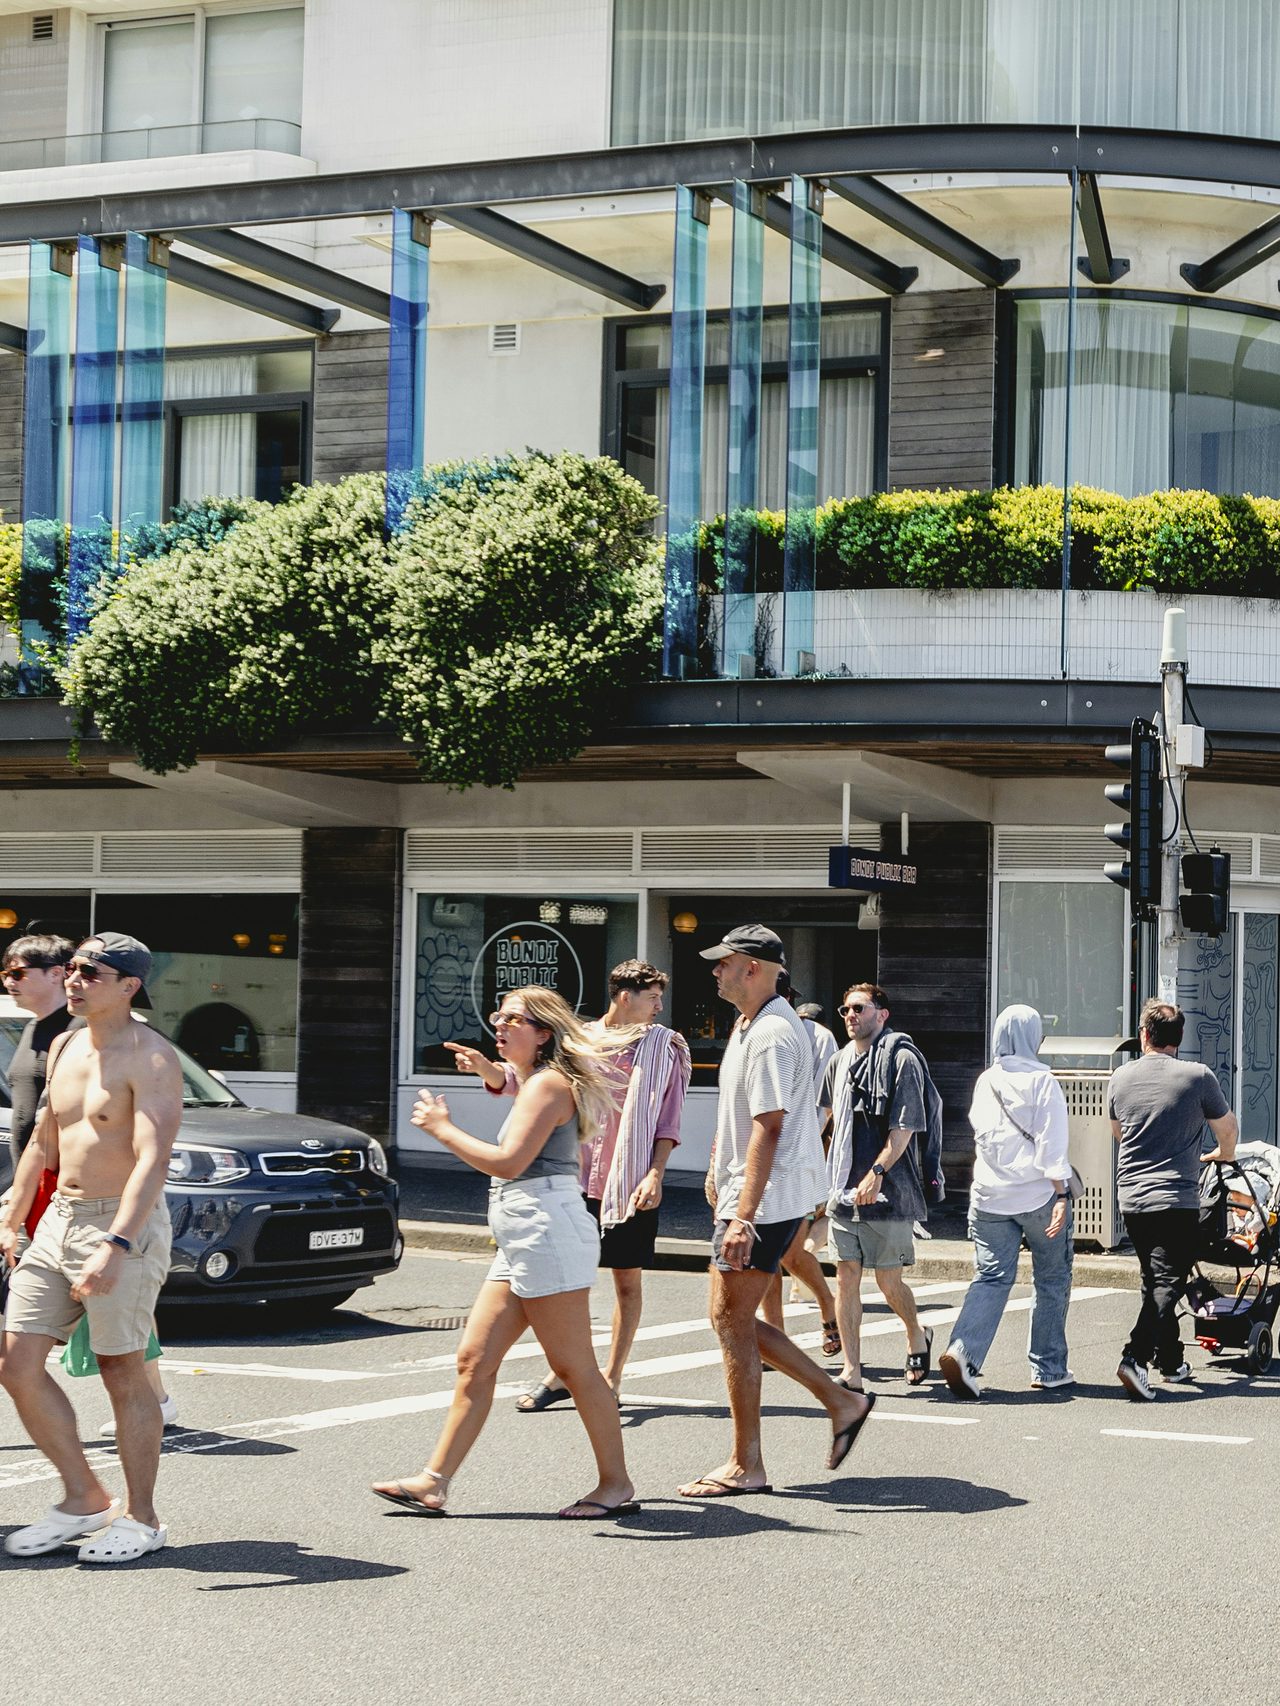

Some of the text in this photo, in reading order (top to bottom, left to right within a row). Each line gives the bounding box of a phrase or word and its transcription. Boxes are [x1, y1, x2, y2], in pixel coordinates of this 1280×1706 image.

[851, 858, 917, 884] BONDI PUBLIC BAR
[496, 939, 559, 964] BONDI
[496, 966, 558, 989] PUBLIC
